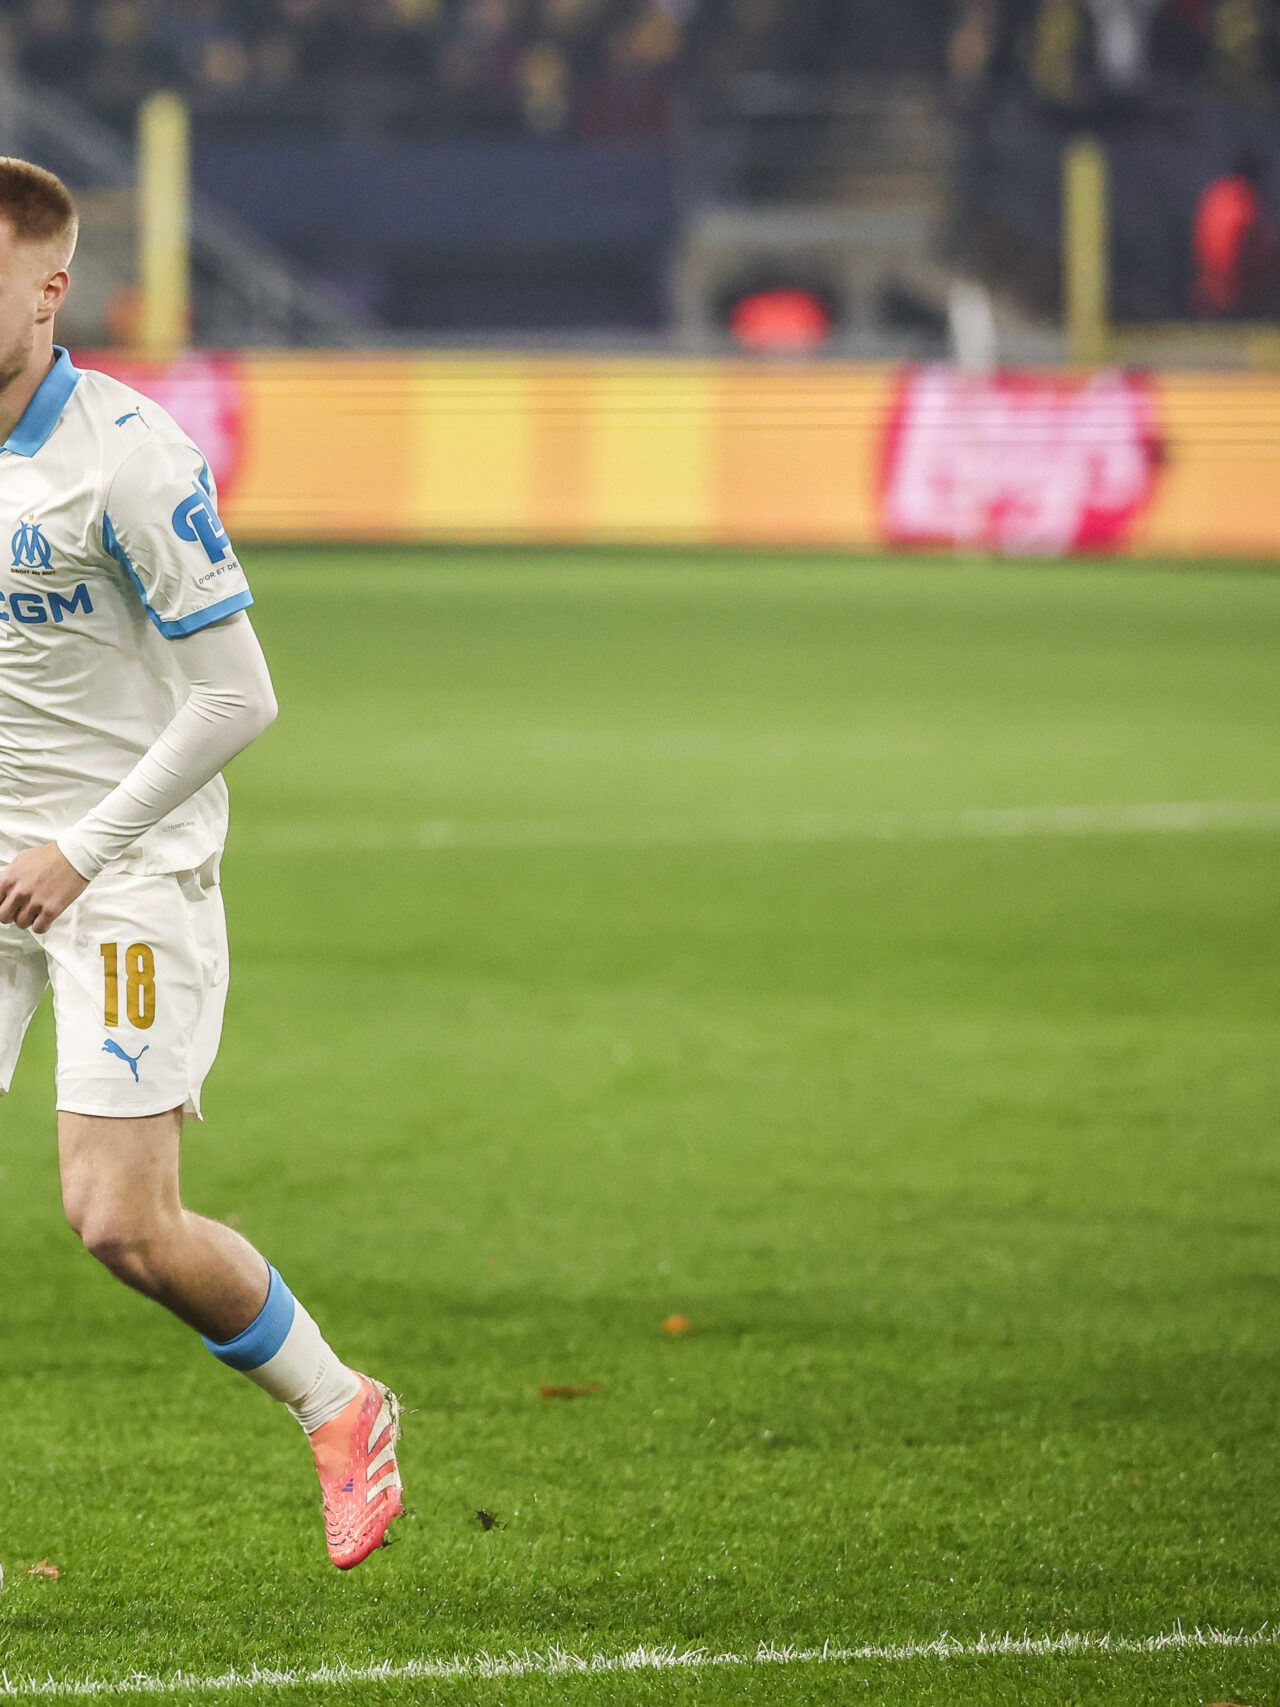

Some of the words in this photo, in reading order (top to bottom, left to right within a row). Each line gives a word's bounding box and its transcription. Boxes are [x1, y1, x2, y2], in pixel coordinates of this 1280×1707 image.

[216, 566, 226, 576] ET
[226, 561, 238, 571] DE
[100, 942, 156, 1030] 18
